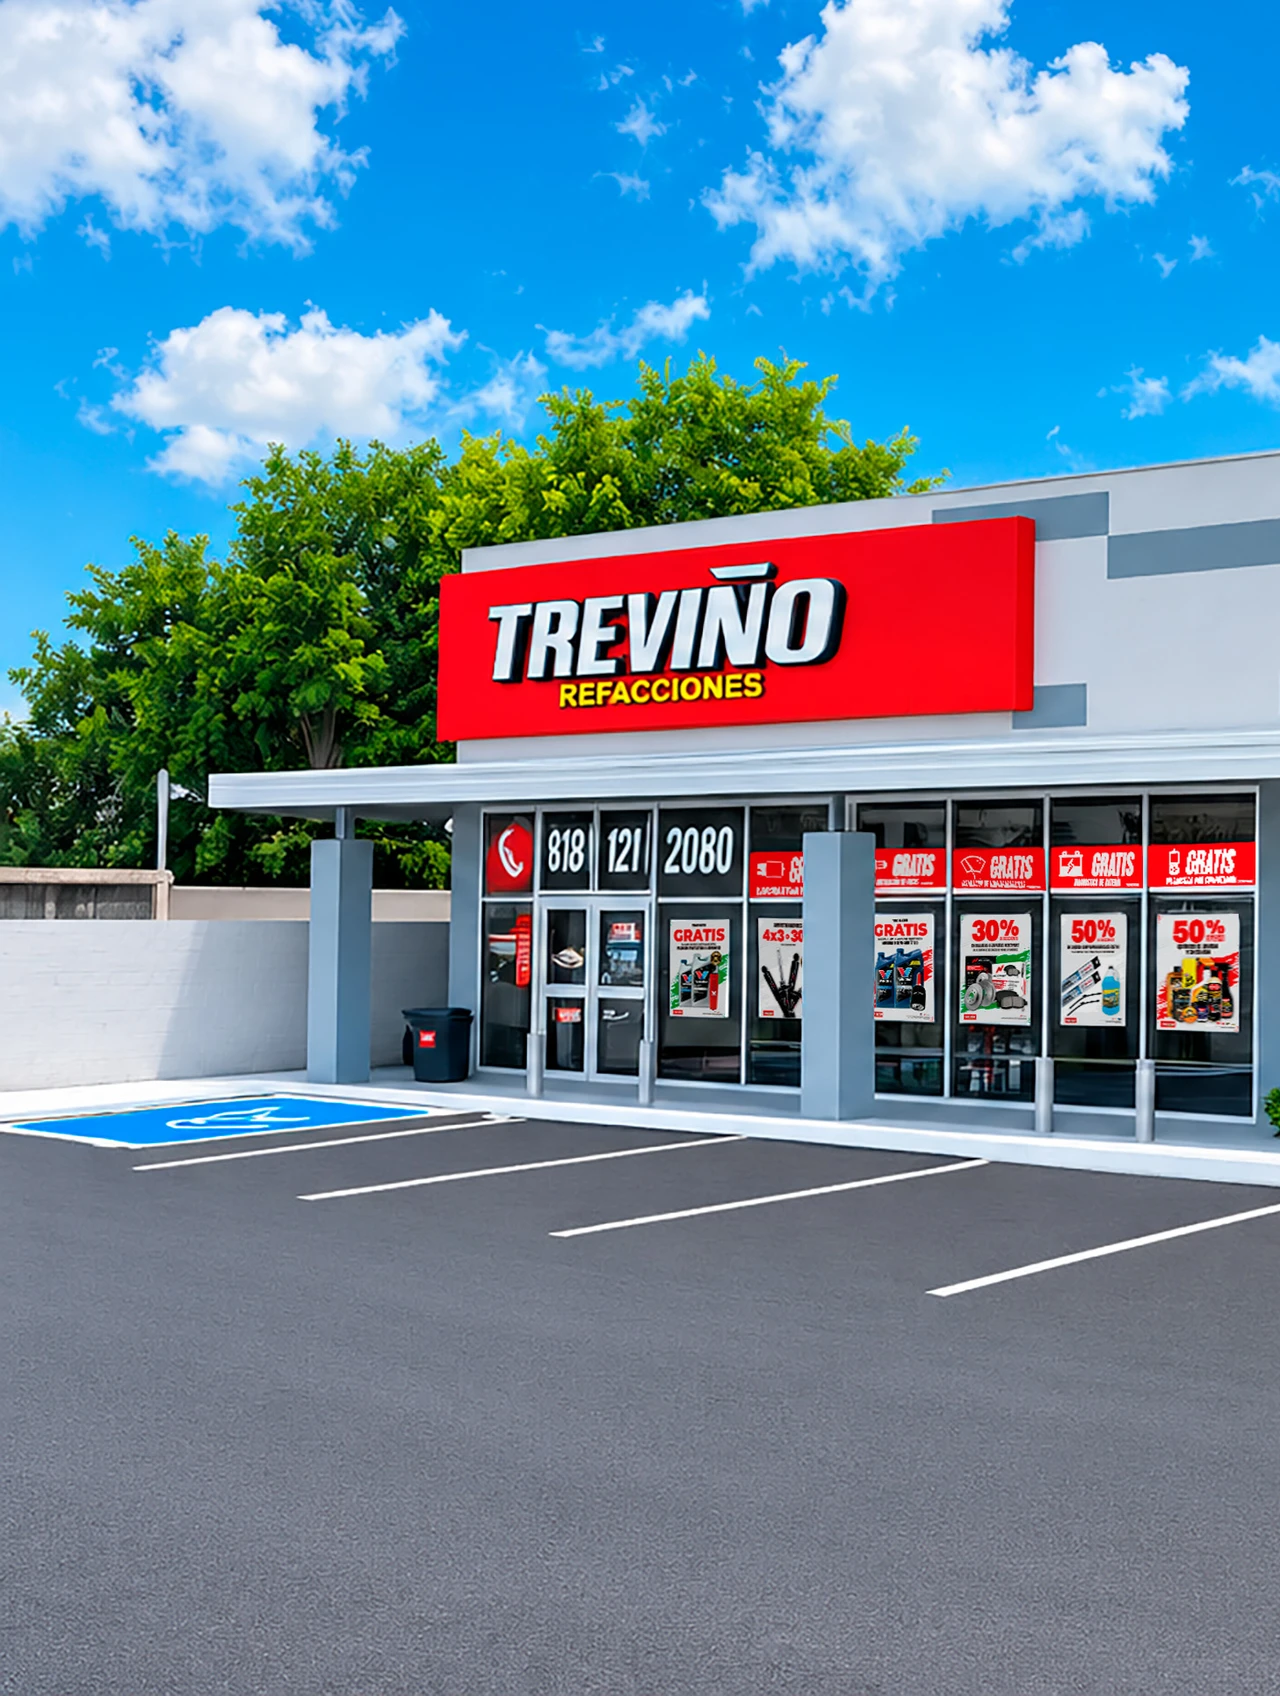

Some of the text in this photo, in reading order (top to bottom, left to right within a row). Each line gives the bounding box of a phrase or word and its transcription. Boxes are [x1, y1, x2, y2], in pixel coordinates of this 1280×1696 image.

[488, 562, 847, 683] TREVIÑO
[559, 673, 764, 708] REFACCIONES
[548, 826, 734, 874] 818 121 2080
[1185, 848, 1236, 876] GRATIS
[892, 853, 936, 877] GRATIS
[990, 855, 1034, 880] GRATIS
[1091, 851, 1135, 877] GRATIS
[673, 928, 725, 942] GRATIS
[874, 923, 928, 937] GRATIS
[972, 919, 1019, 942] 30%
[1071, 919, 1116, 943] 50%
[1172, 919, 1226, 943] 50%
